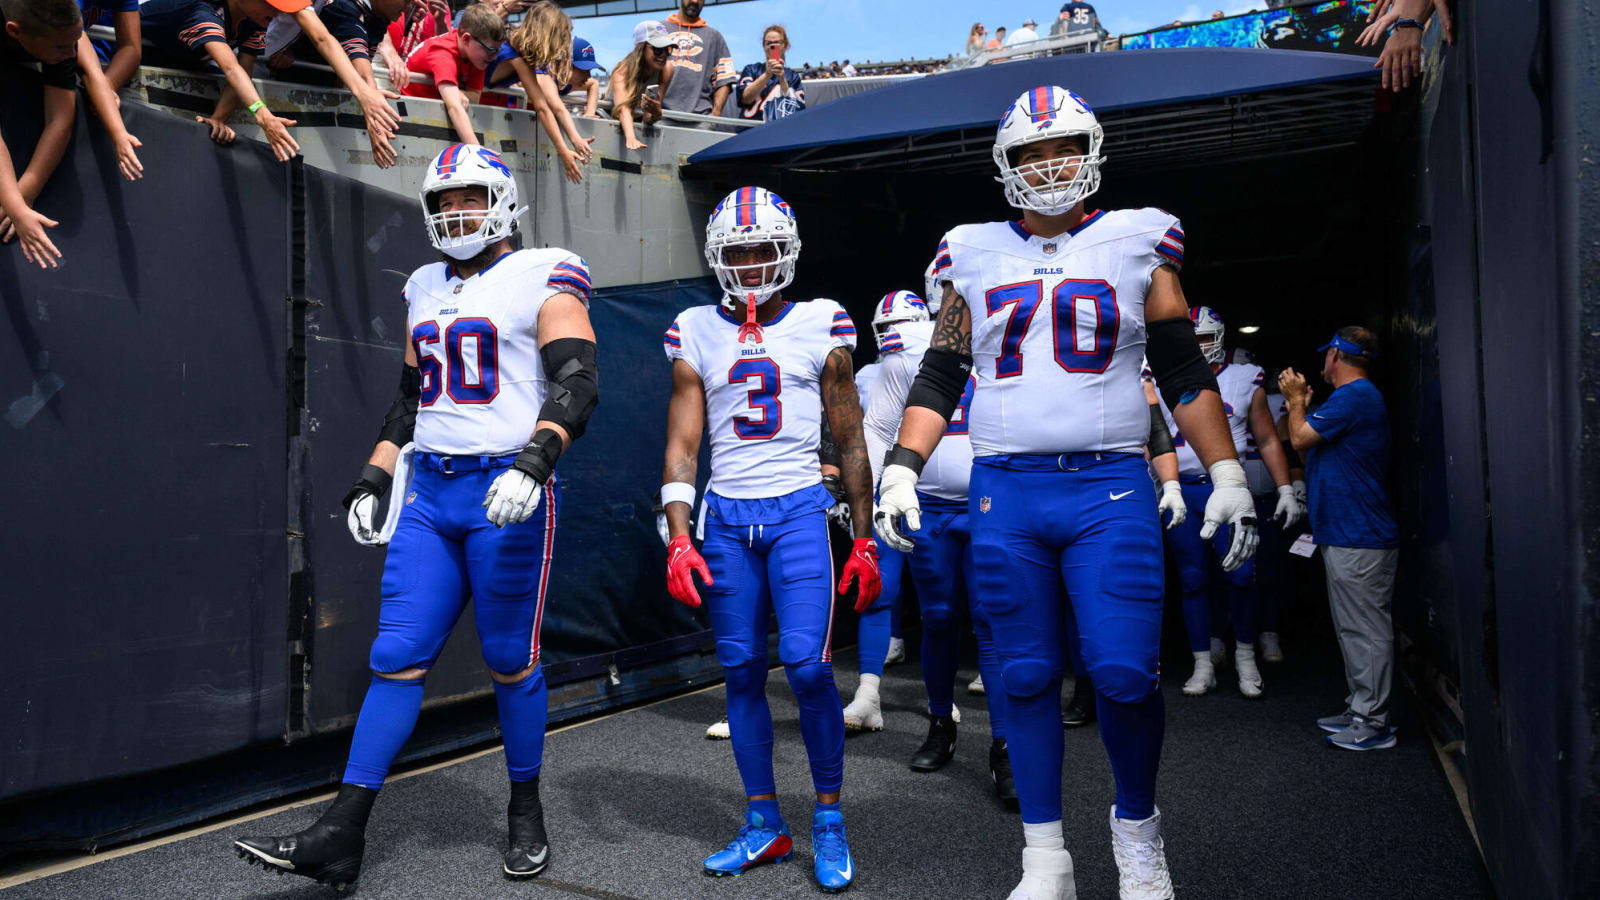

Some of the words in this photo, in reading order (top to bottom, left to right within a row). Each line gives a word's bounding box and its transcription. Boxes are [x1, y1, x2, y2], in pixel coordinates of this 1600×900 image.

[1073, 8, 1089, 24] 35
[1033, 267, 1064, 275] BILLS
[741, 348, 766, 356] BILLS
[985, 278, 1120, 379] 70
[412, 317, 500, 407] 60
[728, 357, 782, 440] 3
